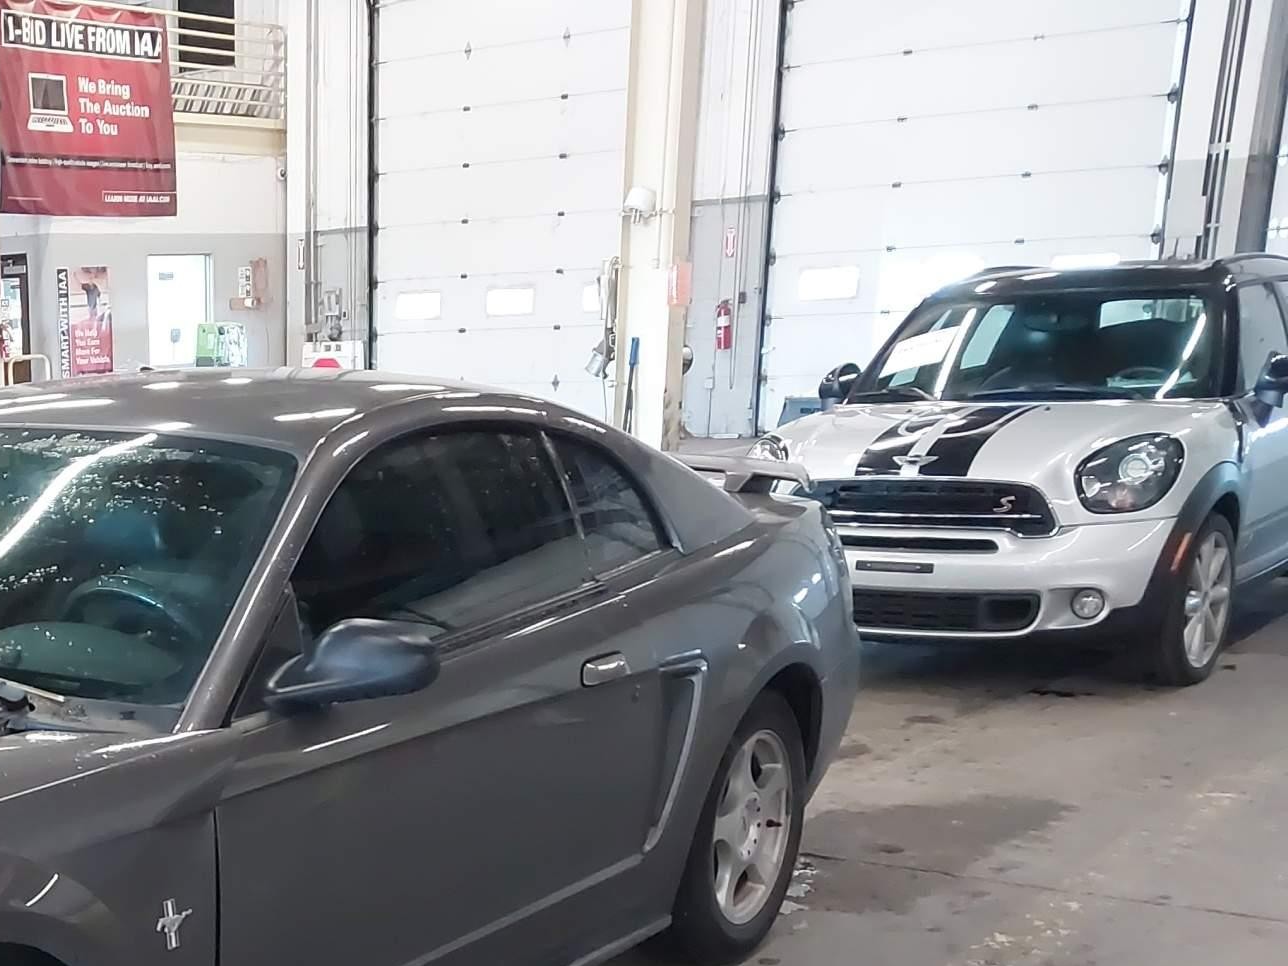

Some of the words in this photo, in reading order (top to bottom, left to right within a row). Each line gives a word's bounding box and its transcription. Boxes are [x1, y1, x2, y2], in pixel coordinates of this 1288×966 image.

[51, 21, 85, 50] LIVE
[87, 25, 130, 55] FROM
[77, 76, 96, 94] We
[98, 78, 130, 100] Bring
[78, 97, 101, 114] The
[103, 99, 150, 118] Auction
[78, 118, 94, 134] To
[96, 119, 118, 136] You
[58, 271, 67, 294] IAA
[59, 297, 69, 333] WITH
[60, 335, 70, 378] SMART
[993, 495, 1016, 513] S
